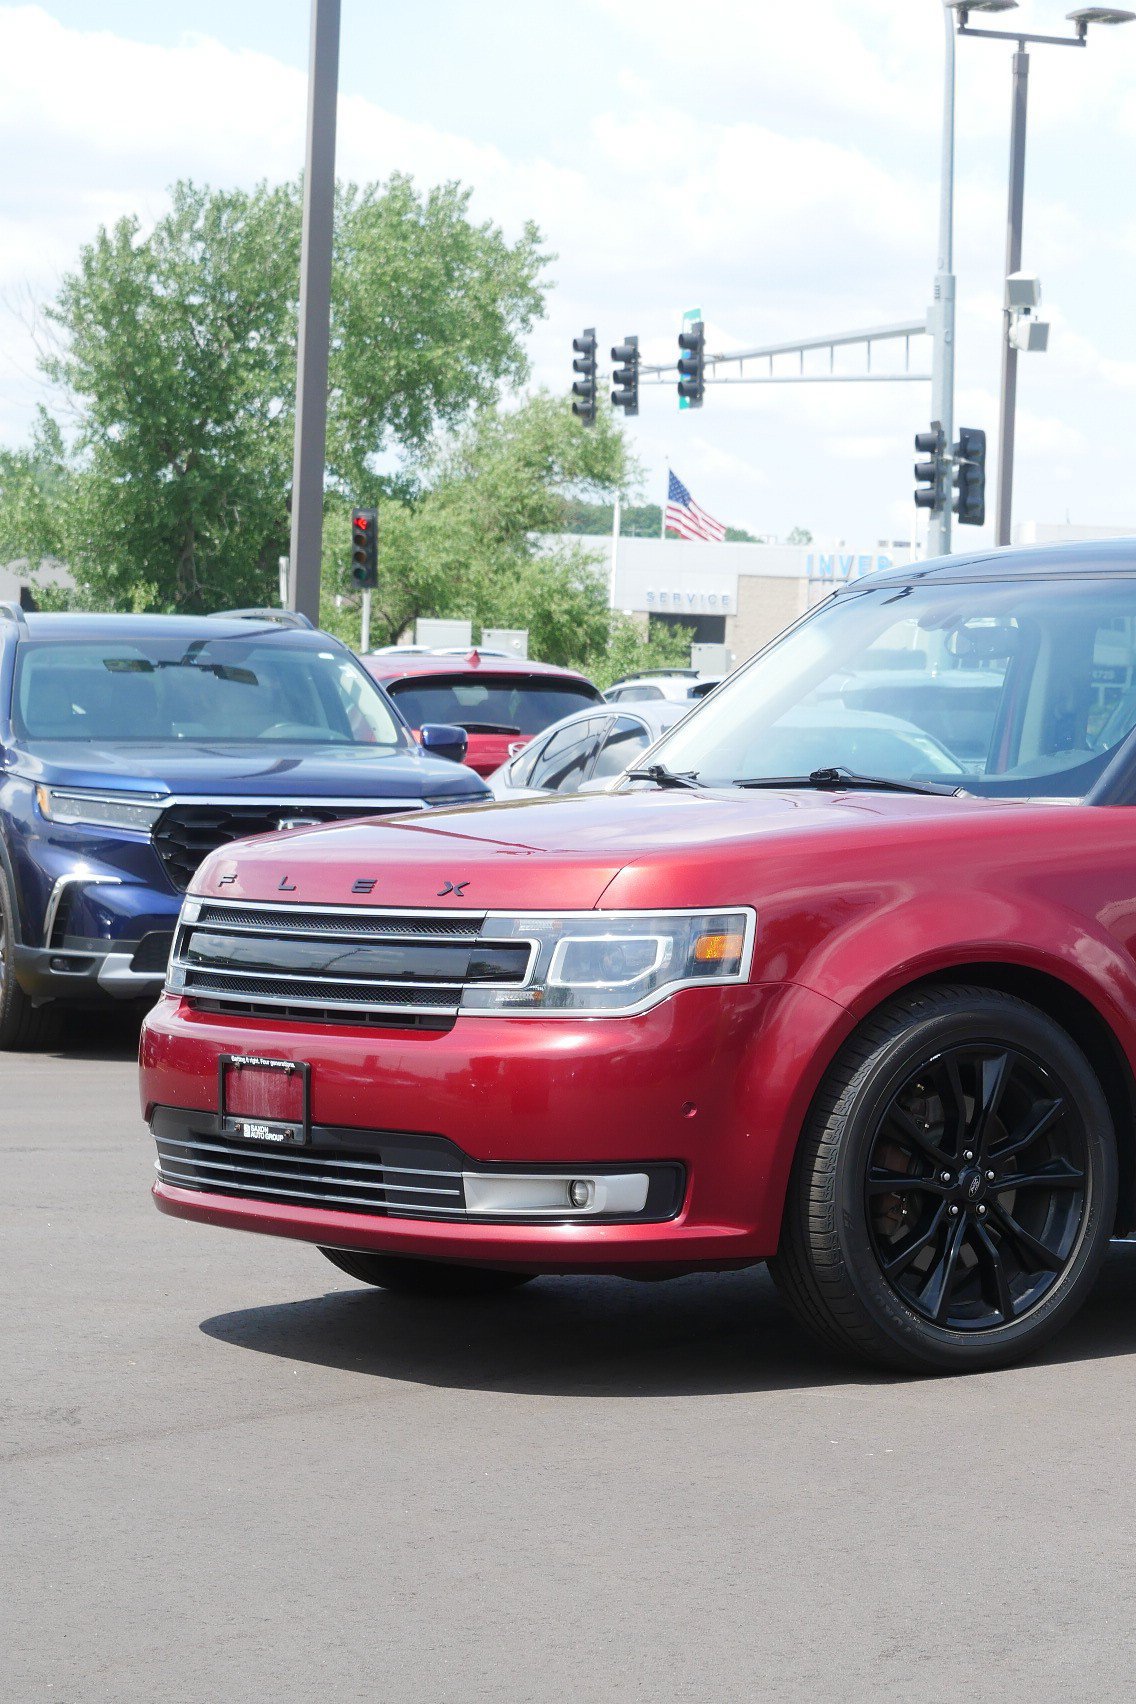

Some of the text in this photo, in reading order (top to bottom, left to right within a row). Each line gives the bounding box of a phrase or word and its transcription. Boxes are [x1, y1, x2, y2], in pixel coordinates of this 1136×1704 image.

[646, 591, 730, 606] SERVICE
[218, 873, 470, 896] FLEX
[250, 1131, 284, 1141] AUTO GROUP
